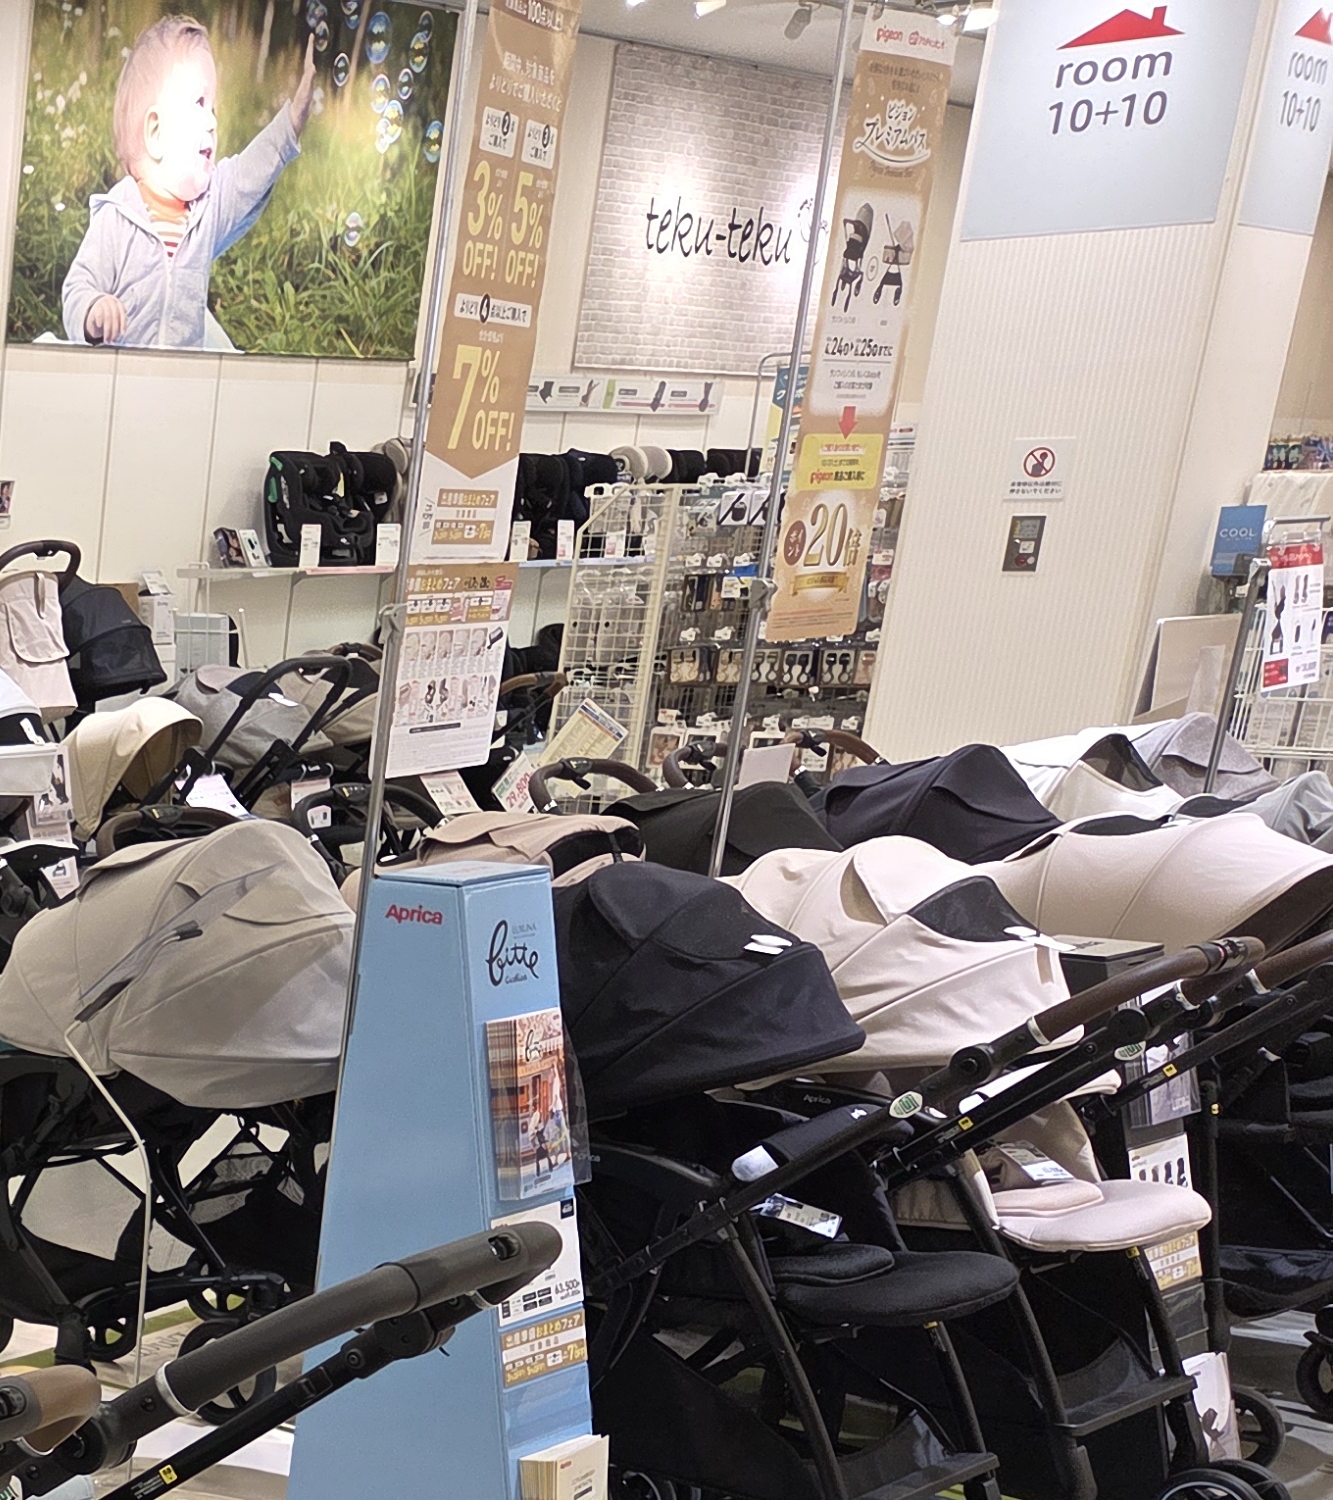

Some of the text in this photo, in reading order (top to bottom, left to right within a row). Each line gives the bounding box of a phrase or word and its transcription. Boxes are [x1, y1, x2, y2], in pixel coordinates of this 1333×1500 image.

[1055, 50, 1173, 89] room
[1287, 49, 1329, 87] room
[1048, 90, 1167, 135] 10+10
[1281, 89, 1321, 133] 10+10
[644, 195, 791, 266] teku-teku
[463, 240, 497, 281] OFF!
[505, 250, 540, 289] OFF!
[472, 410, 515, 451] OFF!
[1219, 527, 1257, 538] COOL
[386, 903, 443, 927] Aprica
